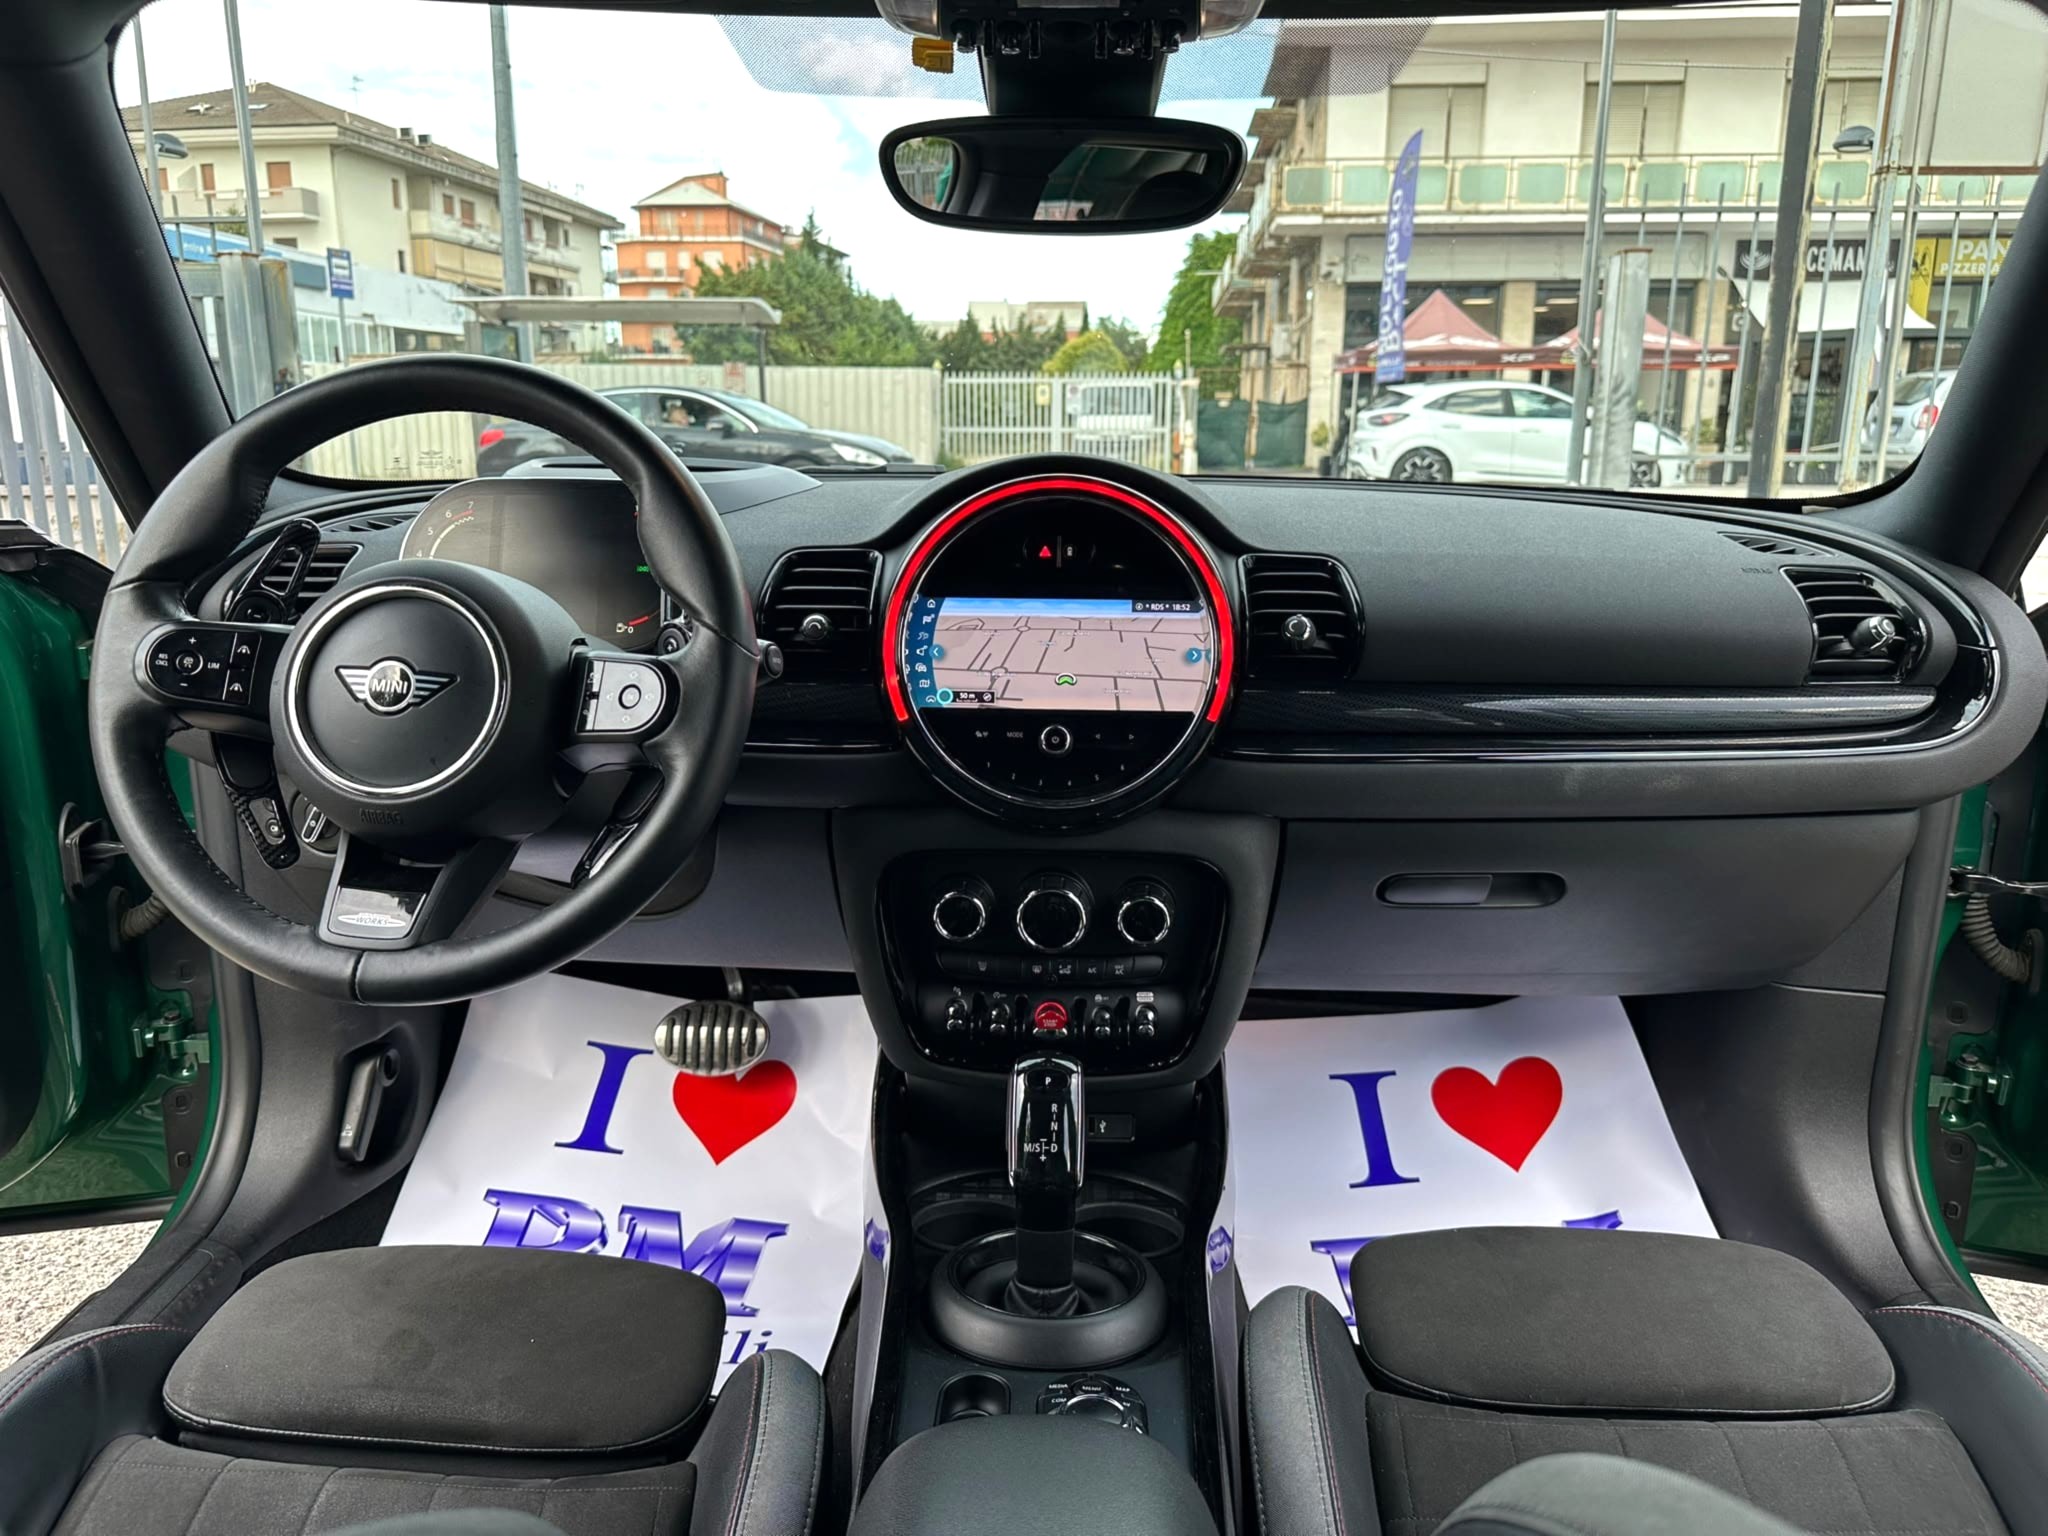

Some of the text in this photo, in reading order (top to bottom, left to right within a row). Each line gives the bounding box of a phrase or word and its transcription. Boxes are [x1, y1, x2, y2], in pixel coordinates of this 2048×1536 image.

[1940, 261, 2001, 276] PZZERA
[445, 510, 453, 519] 6
[427, 527, 434, 536] 5
[207, 661, 221, 670] LIM
[371, 678, 409, 695] MINI
[1006, 731, 1024, 739] MODE
[360, 808, 405, 825] AIRBAG
[355, 915, 389, 926] WORKS
[1044, 1076, 1052, 1085] P
[554, 1040, 654, 1155] I
[1051, 1103, 1058, 1113] R
[1051, 1121, 1058, 1131] N
[1328, 1070, 1420, 1189] I
